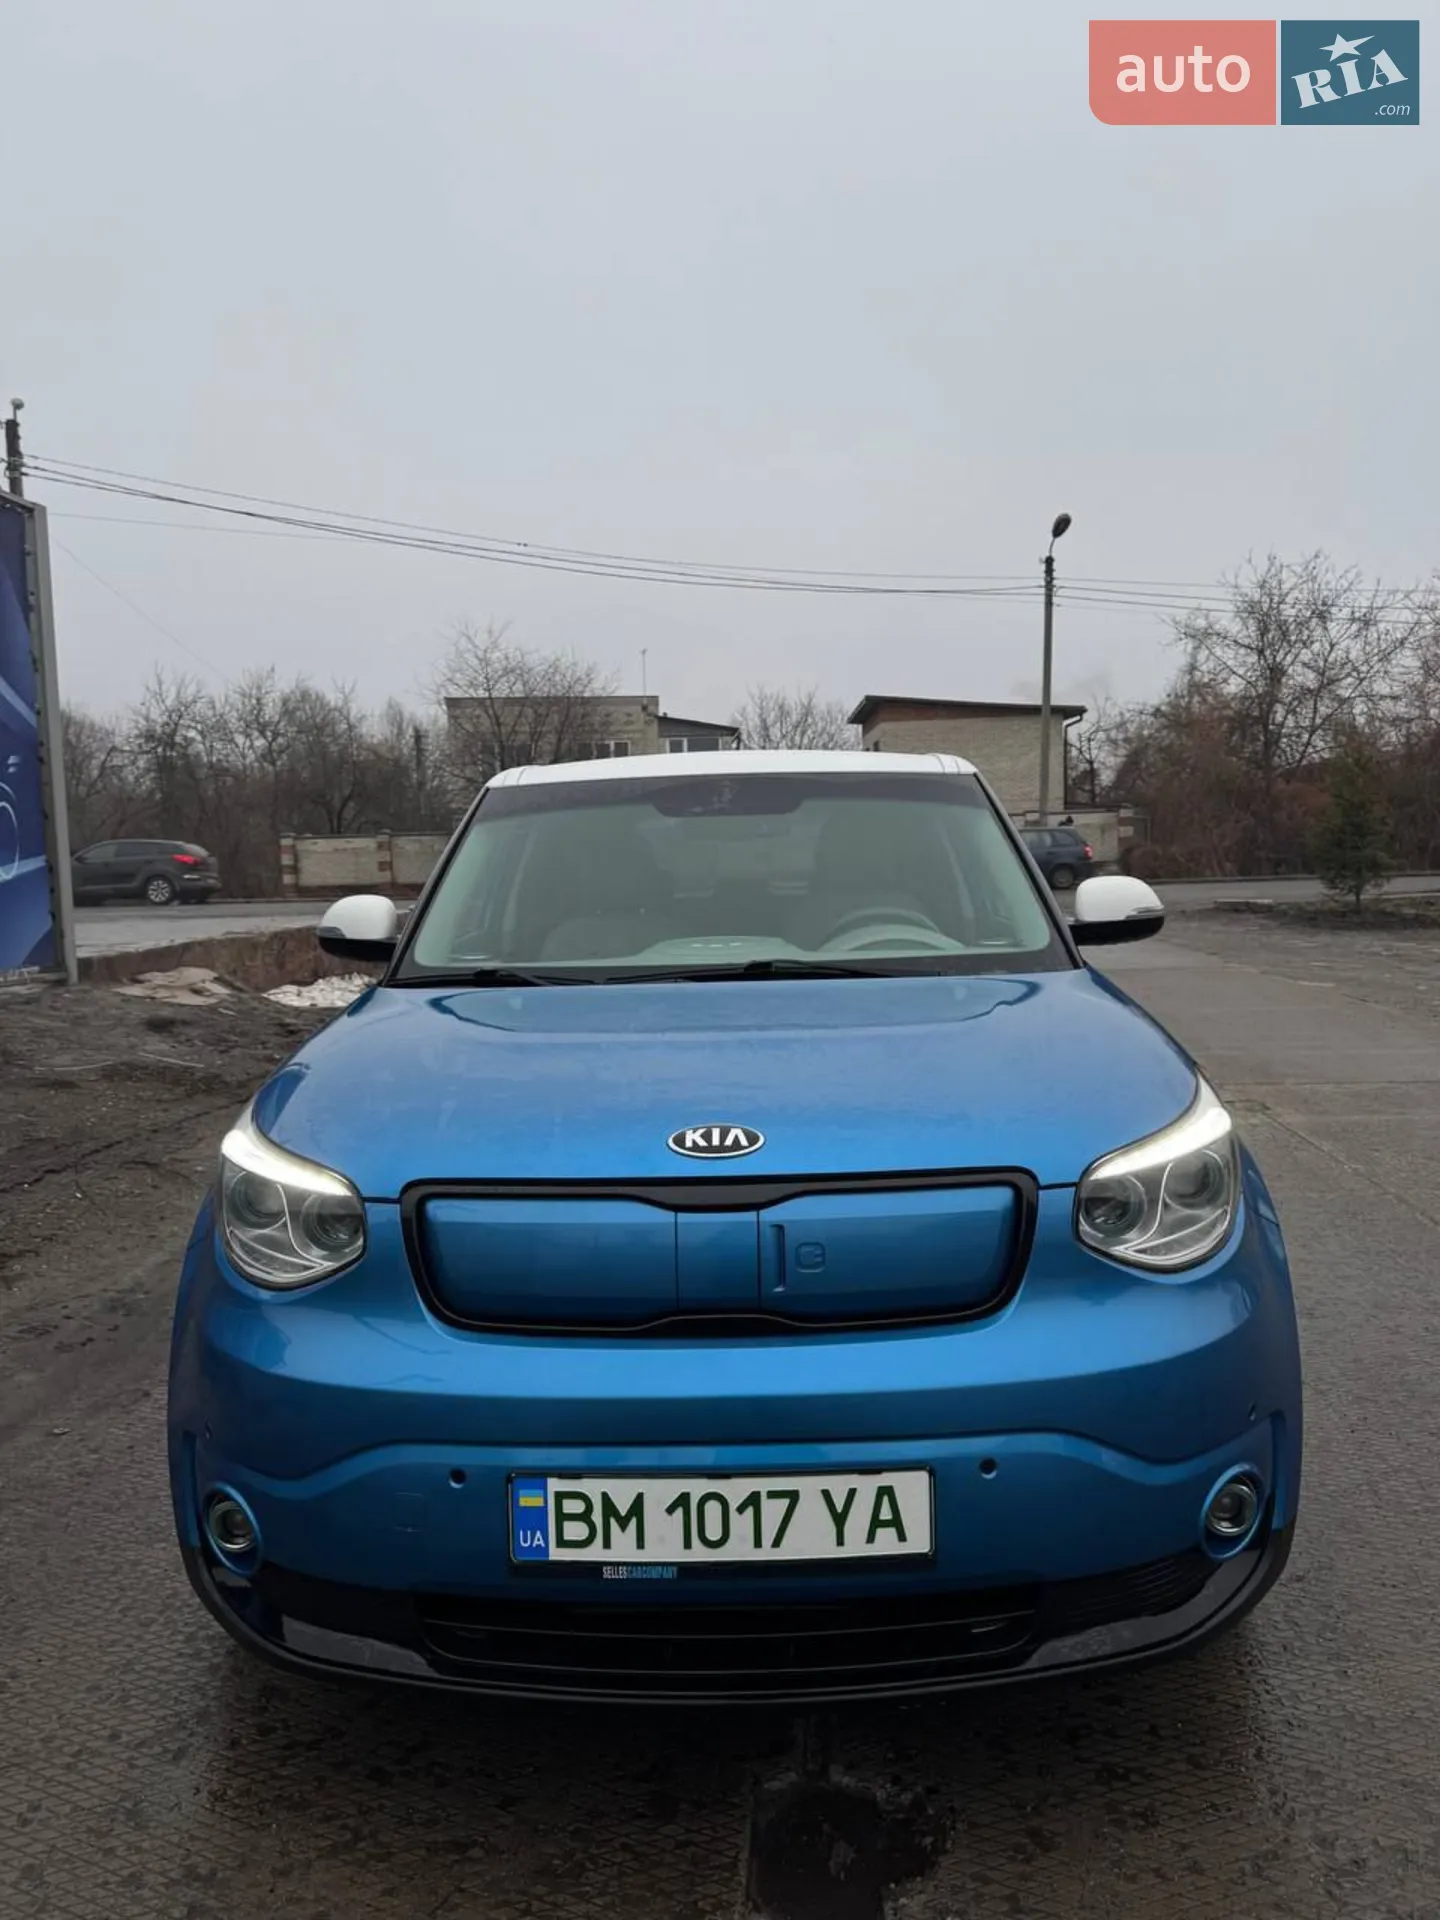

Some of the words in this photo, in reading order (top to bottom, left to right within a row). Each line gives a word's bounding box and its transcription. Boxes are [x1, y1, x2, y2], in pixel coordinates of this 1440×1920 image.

[685, 1128, 749, 1148] KIA
[553, 1490, 645, 1550] BM
[665, 1489, 800, 1549] 1017
[820, 1485, 908, 1547] YA
[519, 1529, 546, 1548] UA
